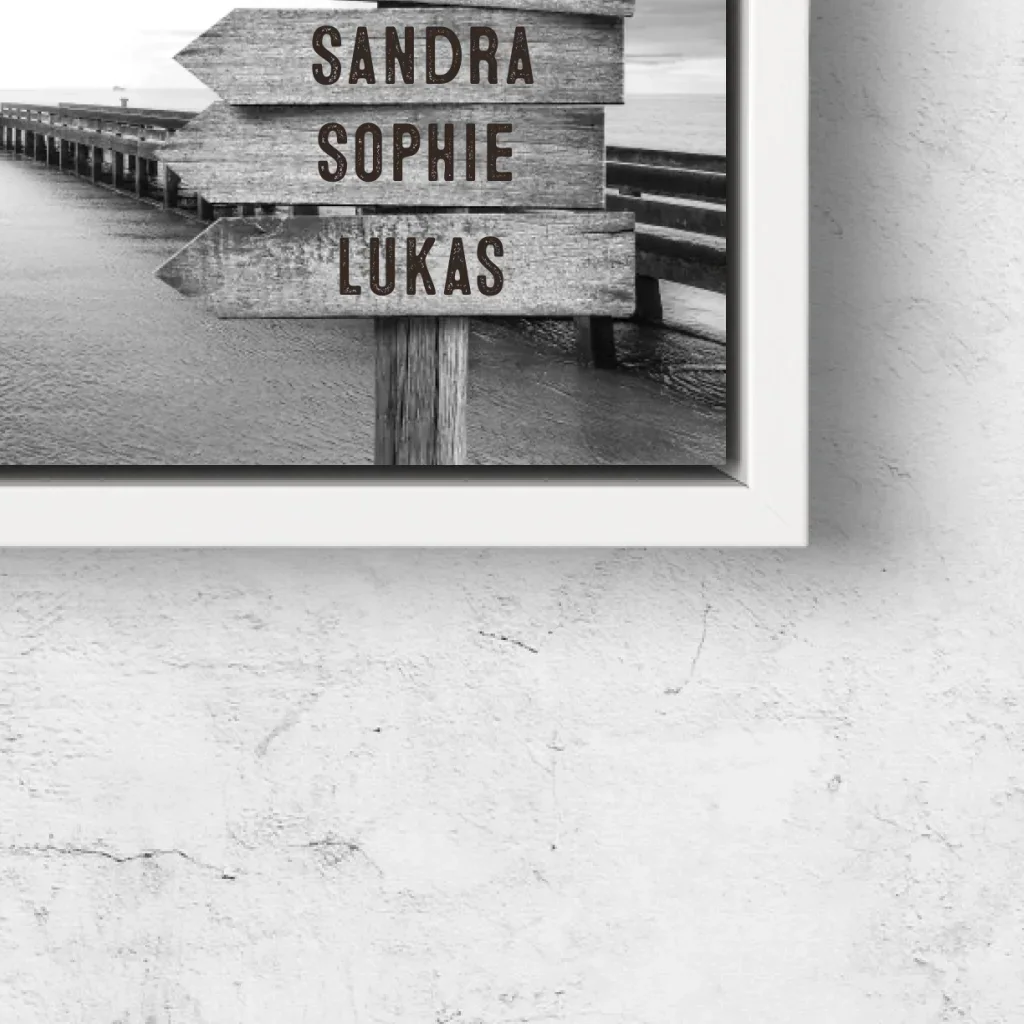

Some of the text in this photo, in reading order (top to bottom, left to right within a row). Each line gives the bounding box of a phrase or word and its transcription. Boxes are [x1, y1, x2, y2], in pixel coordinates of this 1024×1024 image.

[311, 25, 534, 86] SANDRA
[317, 122, 515, 183] SOPHIE
[338, 235, 505, 297] LUKAS
